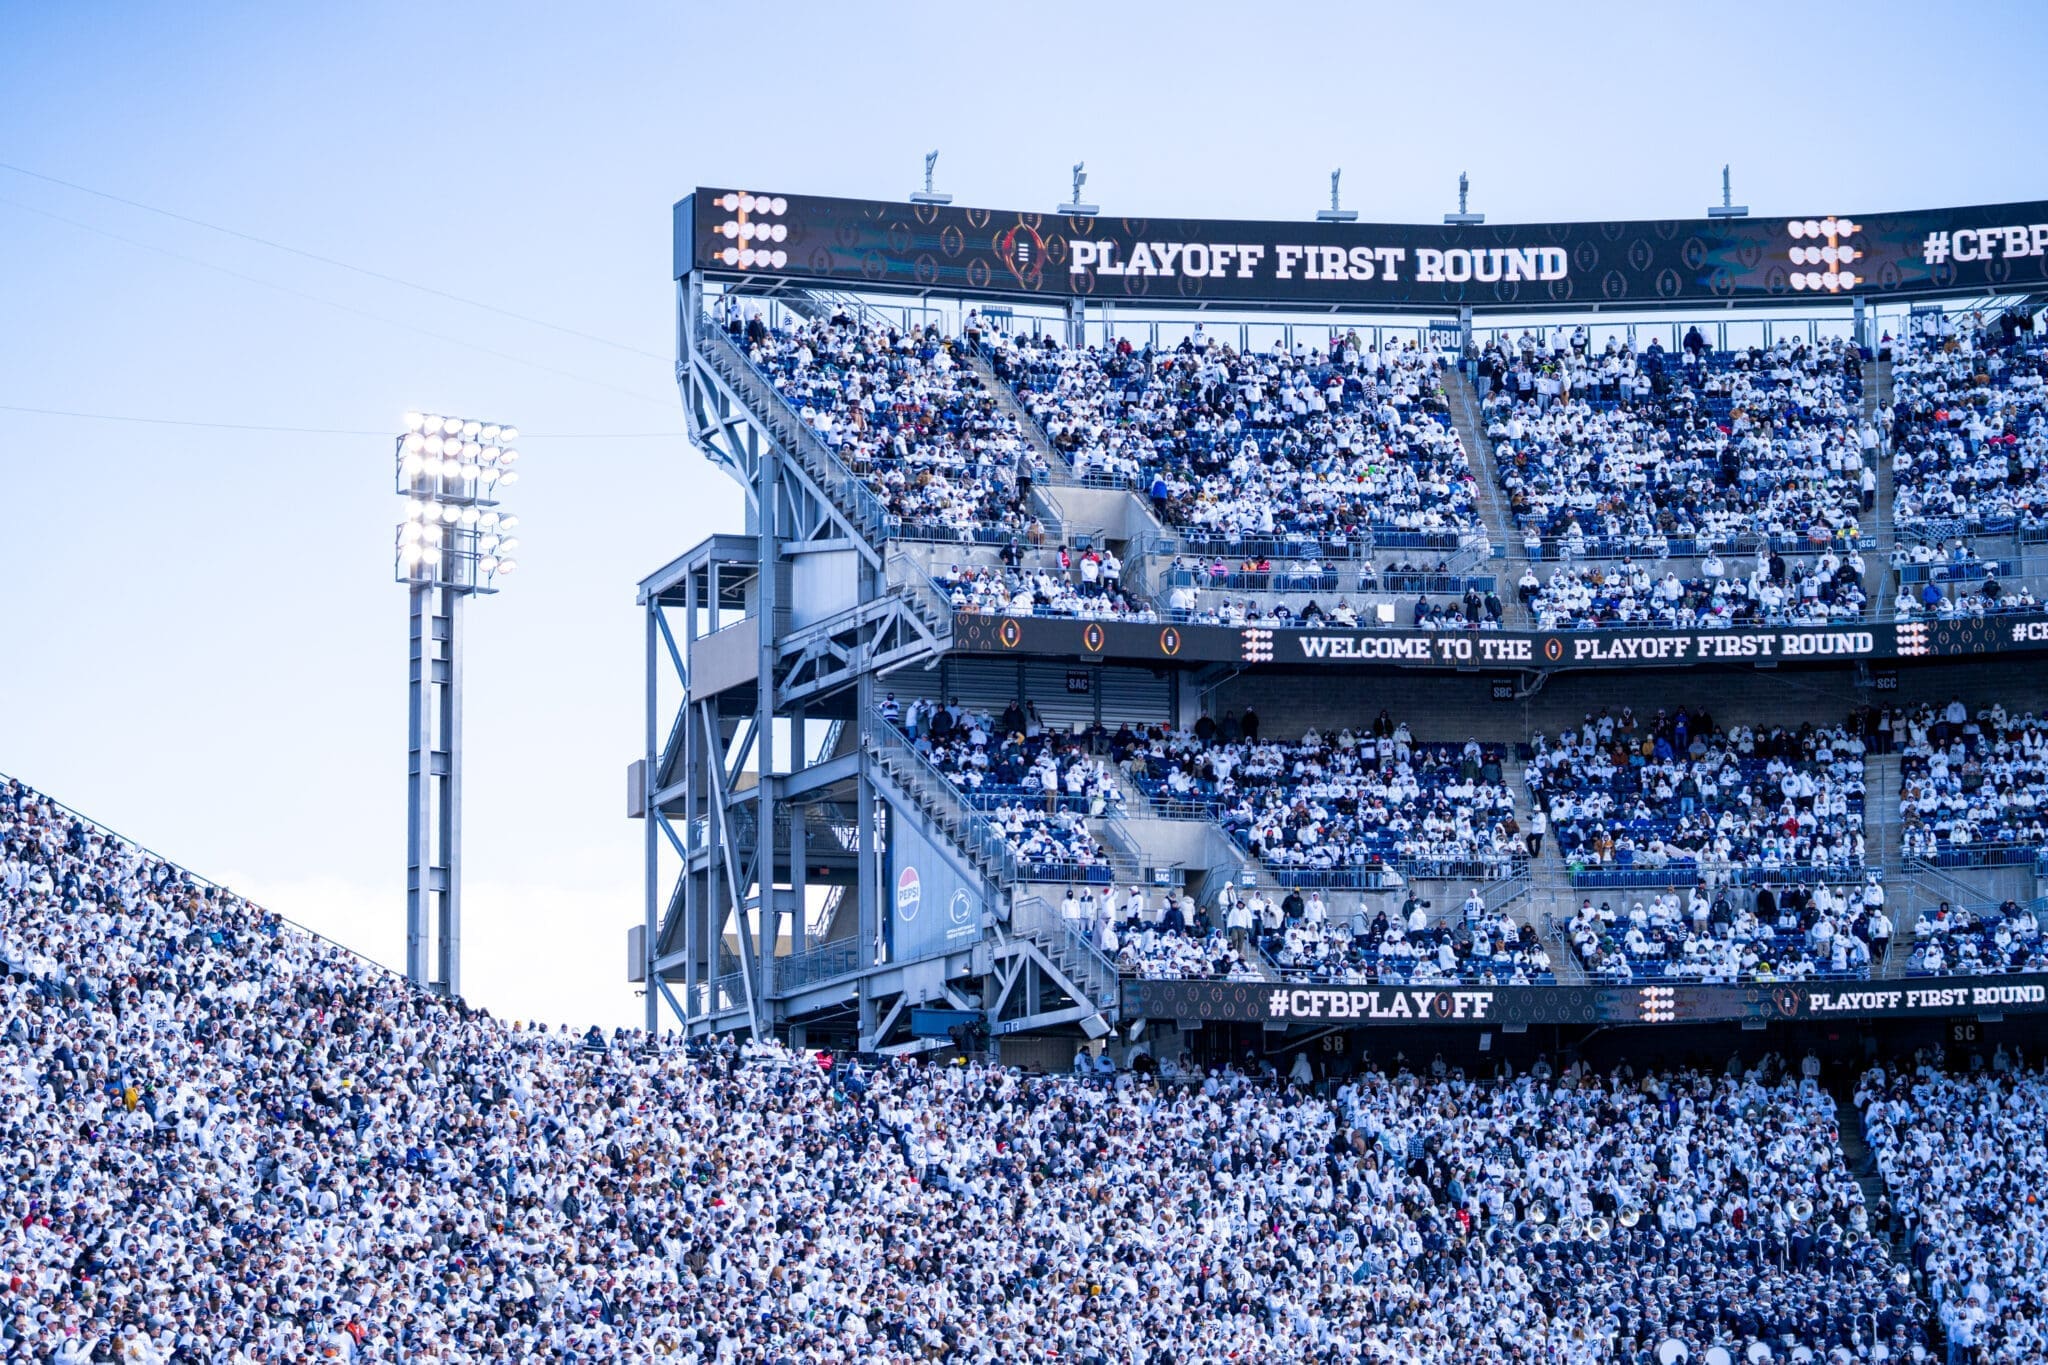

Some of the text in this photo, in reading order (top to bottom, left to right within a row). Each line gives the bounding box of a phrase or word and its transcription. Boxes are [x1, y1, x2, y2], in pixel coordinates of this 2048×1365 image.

[1069, 240, 1568, 283] PLAYOFF FIRST ROUND
[1299, 636, 1532, 660] WELCOME TO THE
[1574, 632, 1873, 660] PLAYOFF FIRST ROUND
[1069, 679, 1088, 690] SAC
[1877, 678, 1897, 689] SCC
[1493, 687, 1512, 698] SBC
[899, 886, 919, 902] PEPSI
[1809, 985, 2045, 1011] PLAYOFF FIRST ROUND
[1954, 1025, 1976, 1041] SC
[1322, 1035, 1344, 1052] SB
